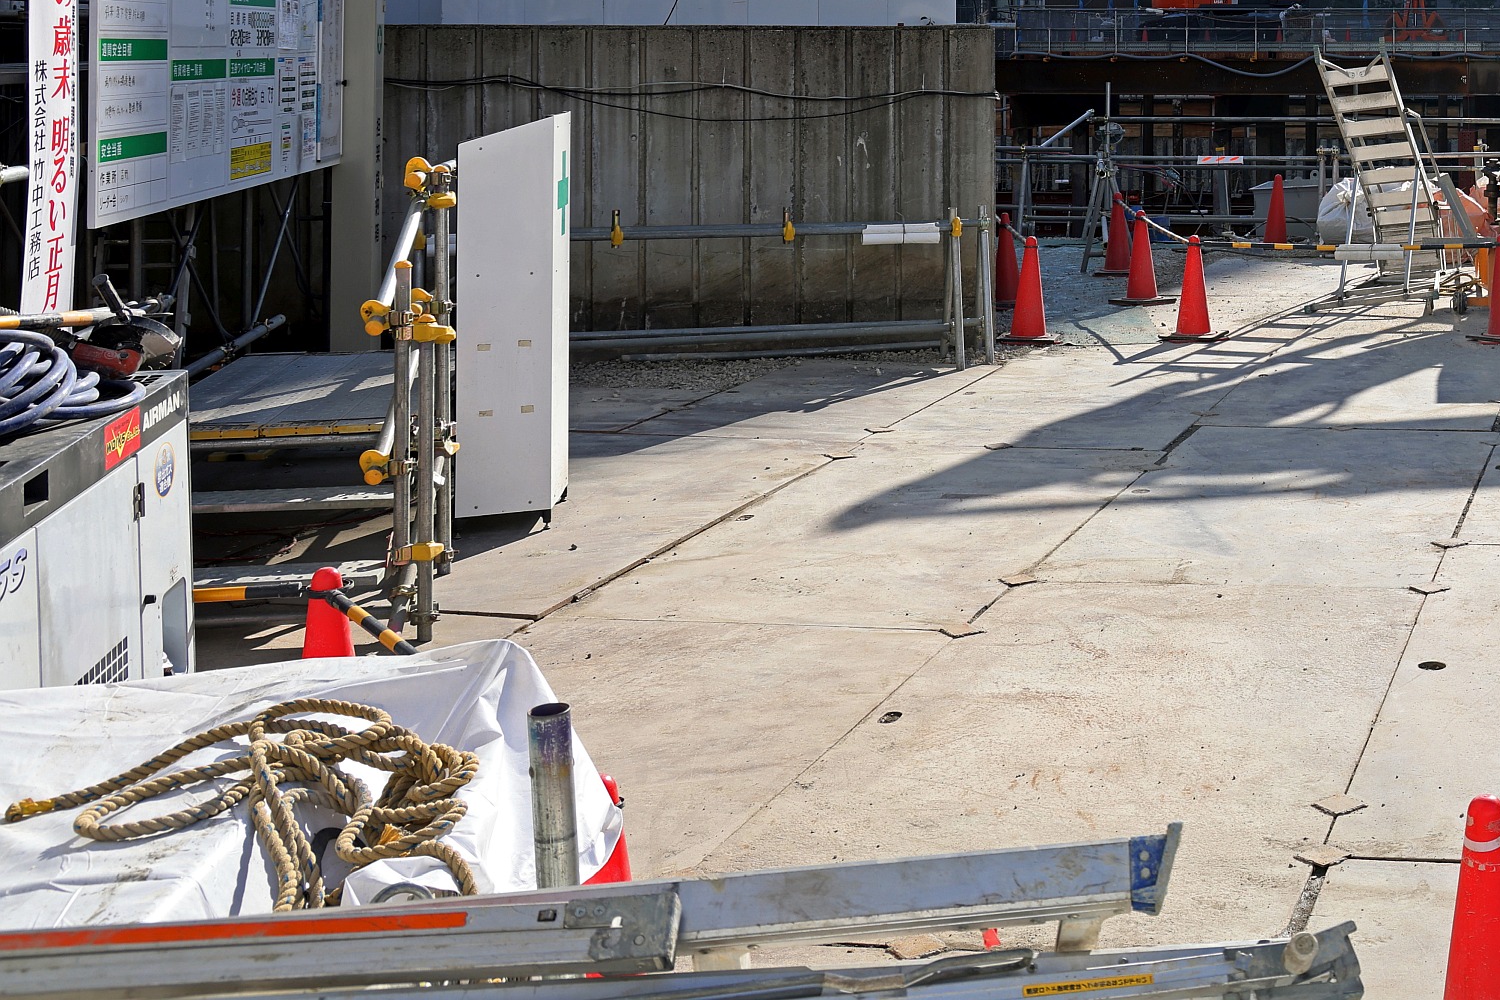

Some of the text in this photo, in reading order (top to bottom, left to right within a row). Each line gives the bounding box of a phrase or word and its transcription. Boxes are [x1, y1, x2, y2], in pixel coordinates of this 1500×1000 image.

[101, 42, 132, 57] 週間安全目標
[28, 59, 47, 282] 株式会社 竹中工務店
[42, 115, 70, 314] 明るい正月
[142, 391, 180, 432] AIRMAN
